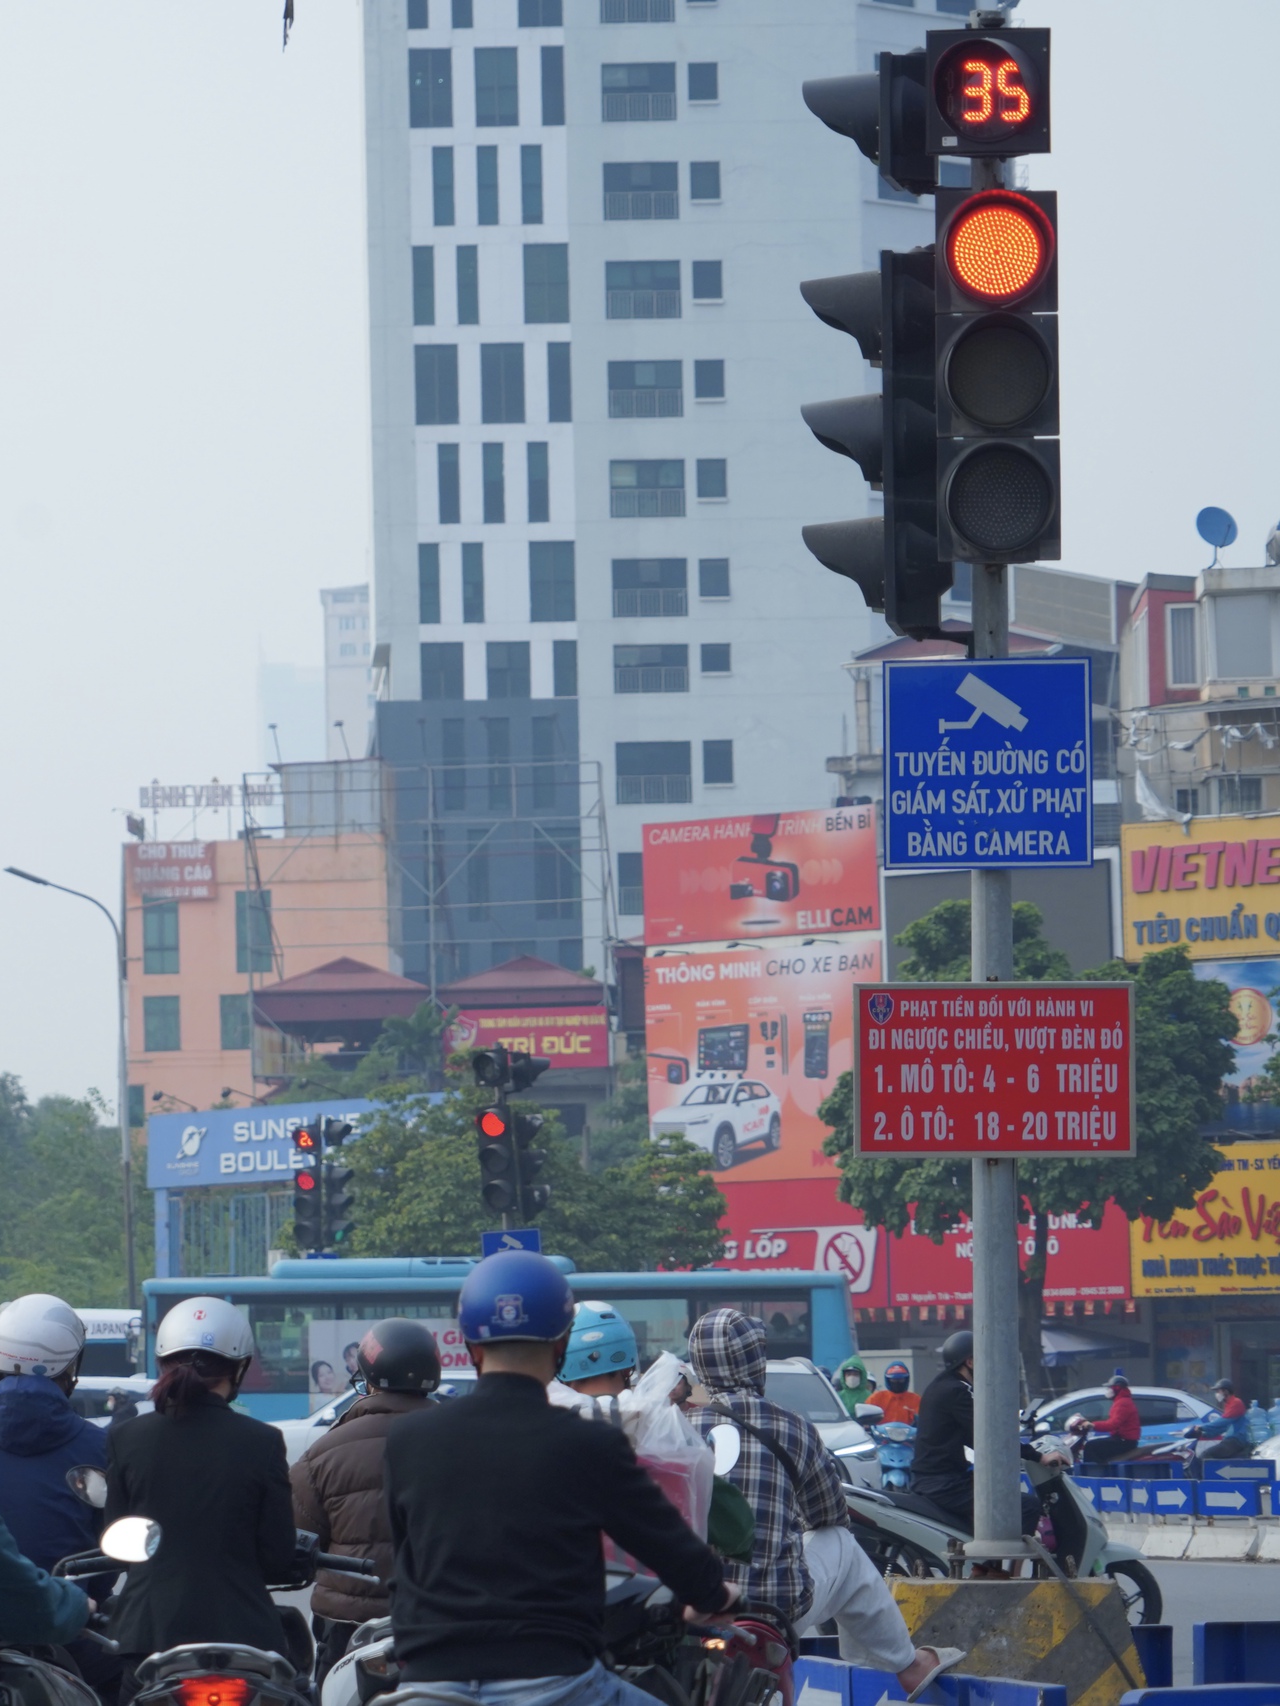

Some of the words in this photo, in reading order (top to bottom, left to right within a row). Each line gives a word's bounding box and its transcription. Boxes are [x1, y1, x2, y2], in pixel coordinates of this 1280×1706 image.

[963, 61, 1029, 121] 35
[895, 737, 966, 777] TUYẾN
[972, 741, 1049, 775] ĐƯỜNG
[1056, 740, 1085, 774] CÓ
[892, 782, 946, 815] GIÁM
[1032, 788, 1086, 818] PHẠT
[648, 824, 711, 846] CAMERA
[777, 816, 821, 836] TRÌNH
[907, 818, 968, 857] BẰNG
[975, 830, 1071, 856] CAMERA
[138, 844, 167, 860] CHO
[184, 864, 212, 881] CÁO
[796, 906, 873, 930] ELLICAM
[1132, 912, 1180, 945] TIÊU
[1185, 903, 1258, 942] CHUẨN
[1264, 911, 1280, 941] Q
[655, 962, 716, 984] THÔNG
[720, 960, 762, 979] MINH
[765, 958, 806, 976] CHO
[811, 956, 833, 973] XE
[838, 954, 875, 975] BẠN
[900, 1000, 937, 1021] PHẠT
[942, 995, 974, 1017] TIỀN
[978, 995, 1003, 1017] ĐỐI
[1008, 996, 1031, 1017] VỚI
[1036, 995, 1075, 1017] HÀNH
[1080, 1000, 1094, 1017] VI
[497, 1033, 536, 1054] TRÍ
[541, 1032, 592, 1054] ĐỨC
[869, 1028, 885, 1049] ĐI
[891, 1027, 948, 1054] NGƯỢC
[954, 1021, 1009, 1052] CHIỀU,
[1015, 1027, 1056, 1054] VƯỢT
[1061, 1023, 1095, 1049] ĐÈN
[1100, 1021, 1123, 1049] ĐỎ
[874, 1064, 893, 1093] 1.
[900, 1057, 934, 1093] MÔ
[941, 1057, 974, 1093] TÔ:
[983, 1064, 996, 1093] 4
[1027, 1064, 1039, 1093] 6
[1056, 1057, 1118, 1099] TRIỆU
[233, 1112, 361, 1143] SUNSIE
[874, 1111, 893, 1140] 2.
[900, 1105, 914, 1140] Ô
[921, 1105, 954, 1140] TÔ:
[974, 1112, 1000, 1140] 18
[1022, 1112, 1048, 1140] 20
[1055, 1105, 1117, 1147] TRIỆU
[1267, 1154, 1280, 1170] YẾ
[743, 1231, 787, 1259] LỐP
